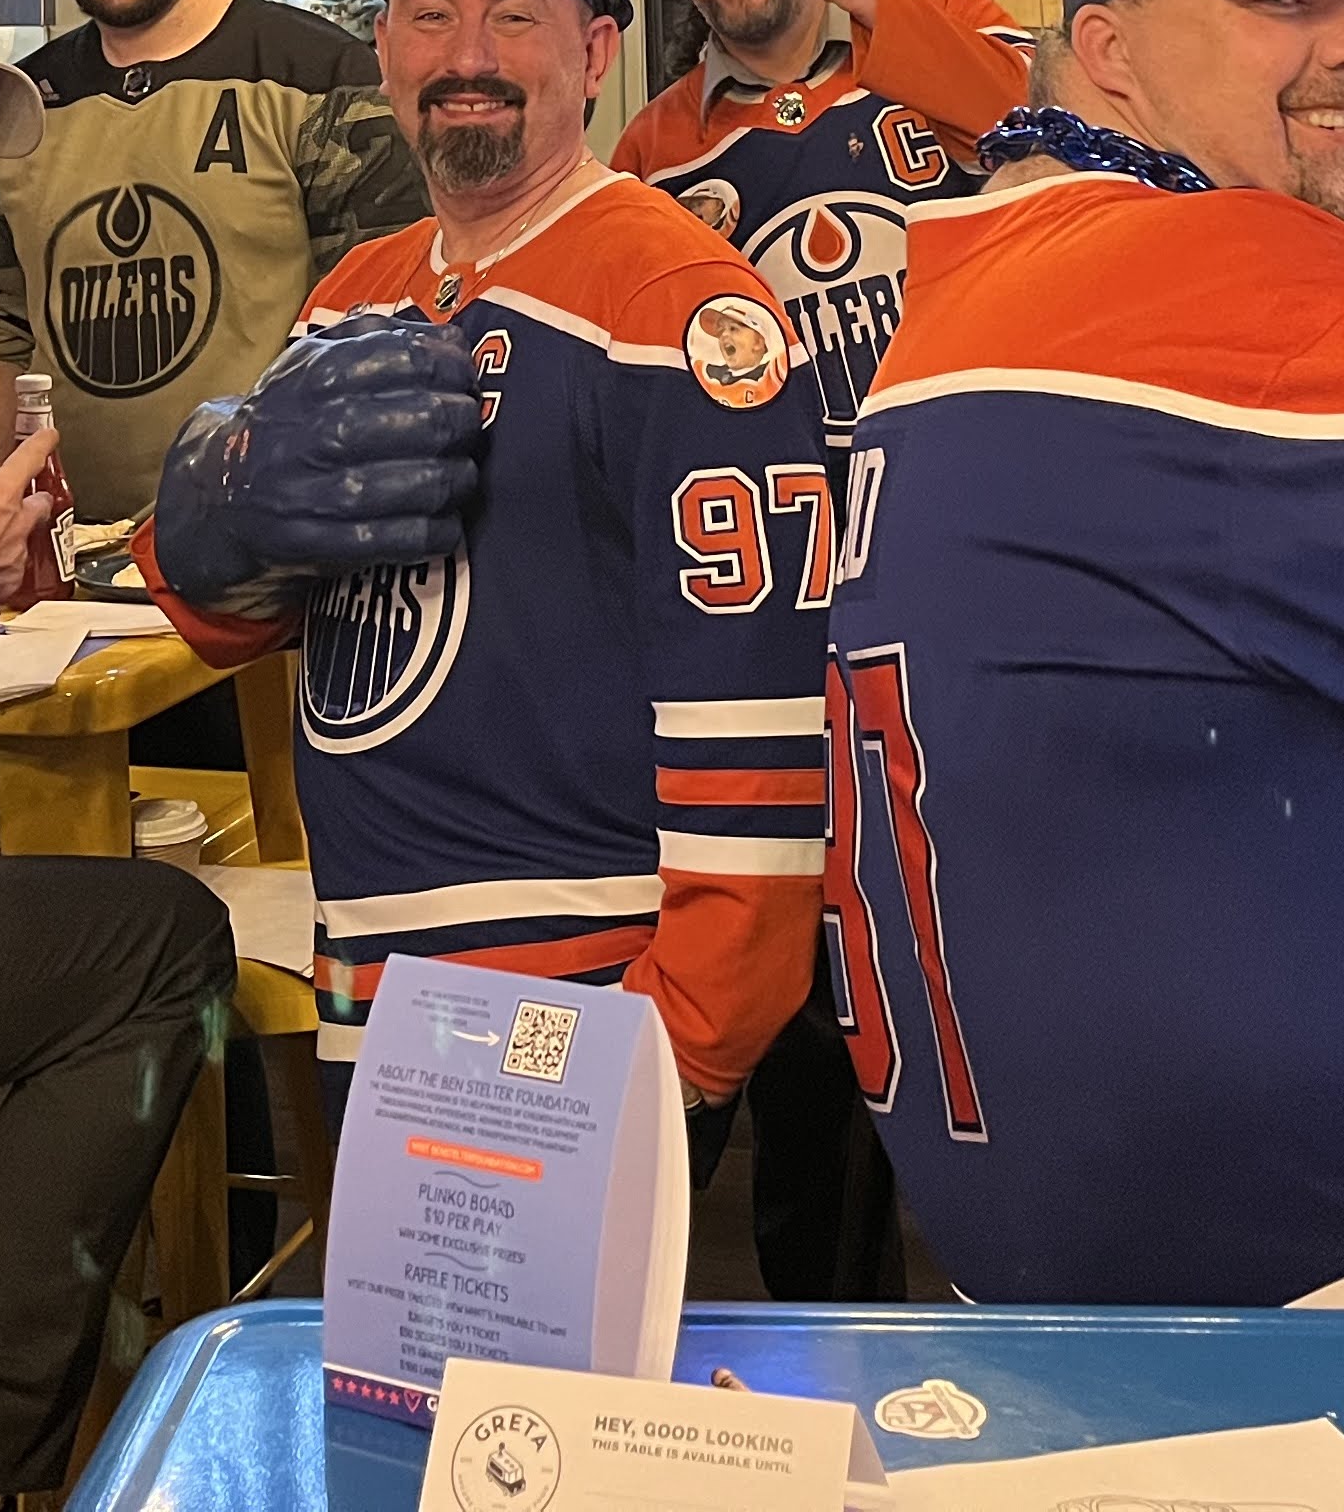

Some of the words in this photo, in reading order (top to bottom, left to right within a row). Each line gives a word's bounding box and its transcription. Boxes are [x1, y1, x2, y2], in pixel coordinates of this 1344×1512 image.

[193, 87, 248, 174] A
[872, 104, 949, 191] C
[60, 255, 196, 360] OILERS
[670, 462, 835, 615] 97
[377, 1064, 416, 1083] ABOUT
[418, 1071, 441, 1088] THE
[440, 1075, 464, 1092] BEN
[466, 1079, 514, 1102] STELTER
[515, 1089, 591, 1117] FOUNDATION
[418, 1183, 467, 1208] PLINKO
[469, 1193, 515, 1219] BOARD
[424, 1206, 446, 1226] $10
[447, 1211, 470, 1231] PER
[472, 1217, 503, 1237] PLAY
[398, 1227, 416, 1240] WIN
[418, 1231, 441, 1246] SOME
[405, 1263, 448, 1290] RAFFLE
[452, 1274, 510, 1303] TICKETS
[474, 1412, 548, 1453] GRETA
[594, 1414, 636, 1438] HEY,
[643, 1421, 699, 1442] GOOD
[705, 1428, 794, 1455] LOOKING
[592, 1438, 620, 1452] THIS
[624, 1442, 663, 1458] TABLE
[666, 1447, 679, 1460] IS
[682, 1450, 751, 1469] AVAILABLE
[755, 1458, 793, 1475] UNTIL
